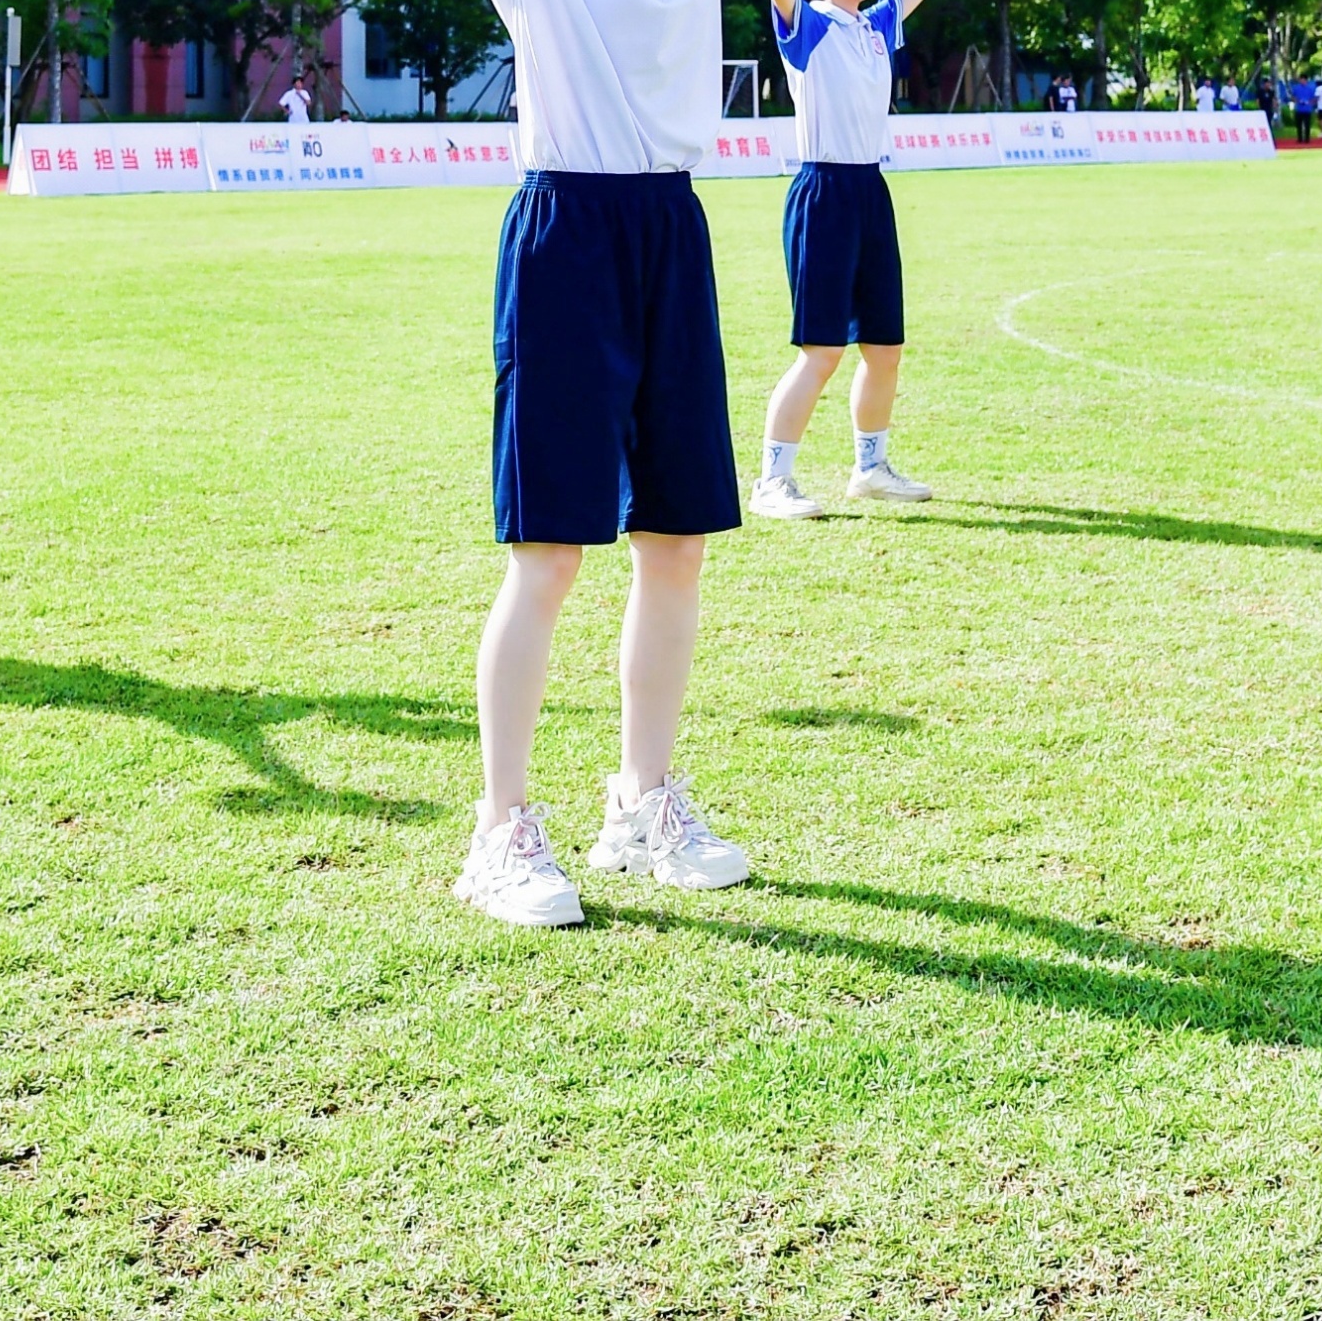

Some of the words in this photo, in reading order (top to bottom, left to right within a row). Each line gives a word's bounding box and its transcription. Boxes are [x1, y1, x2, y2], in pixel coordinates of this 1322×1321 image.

[717, 137, 771, 157] 教育局
[31, 148, 78, 172] 团结
[94, 148, 139, 171] 担当
[154, 147, 199, 169] 拼搏
